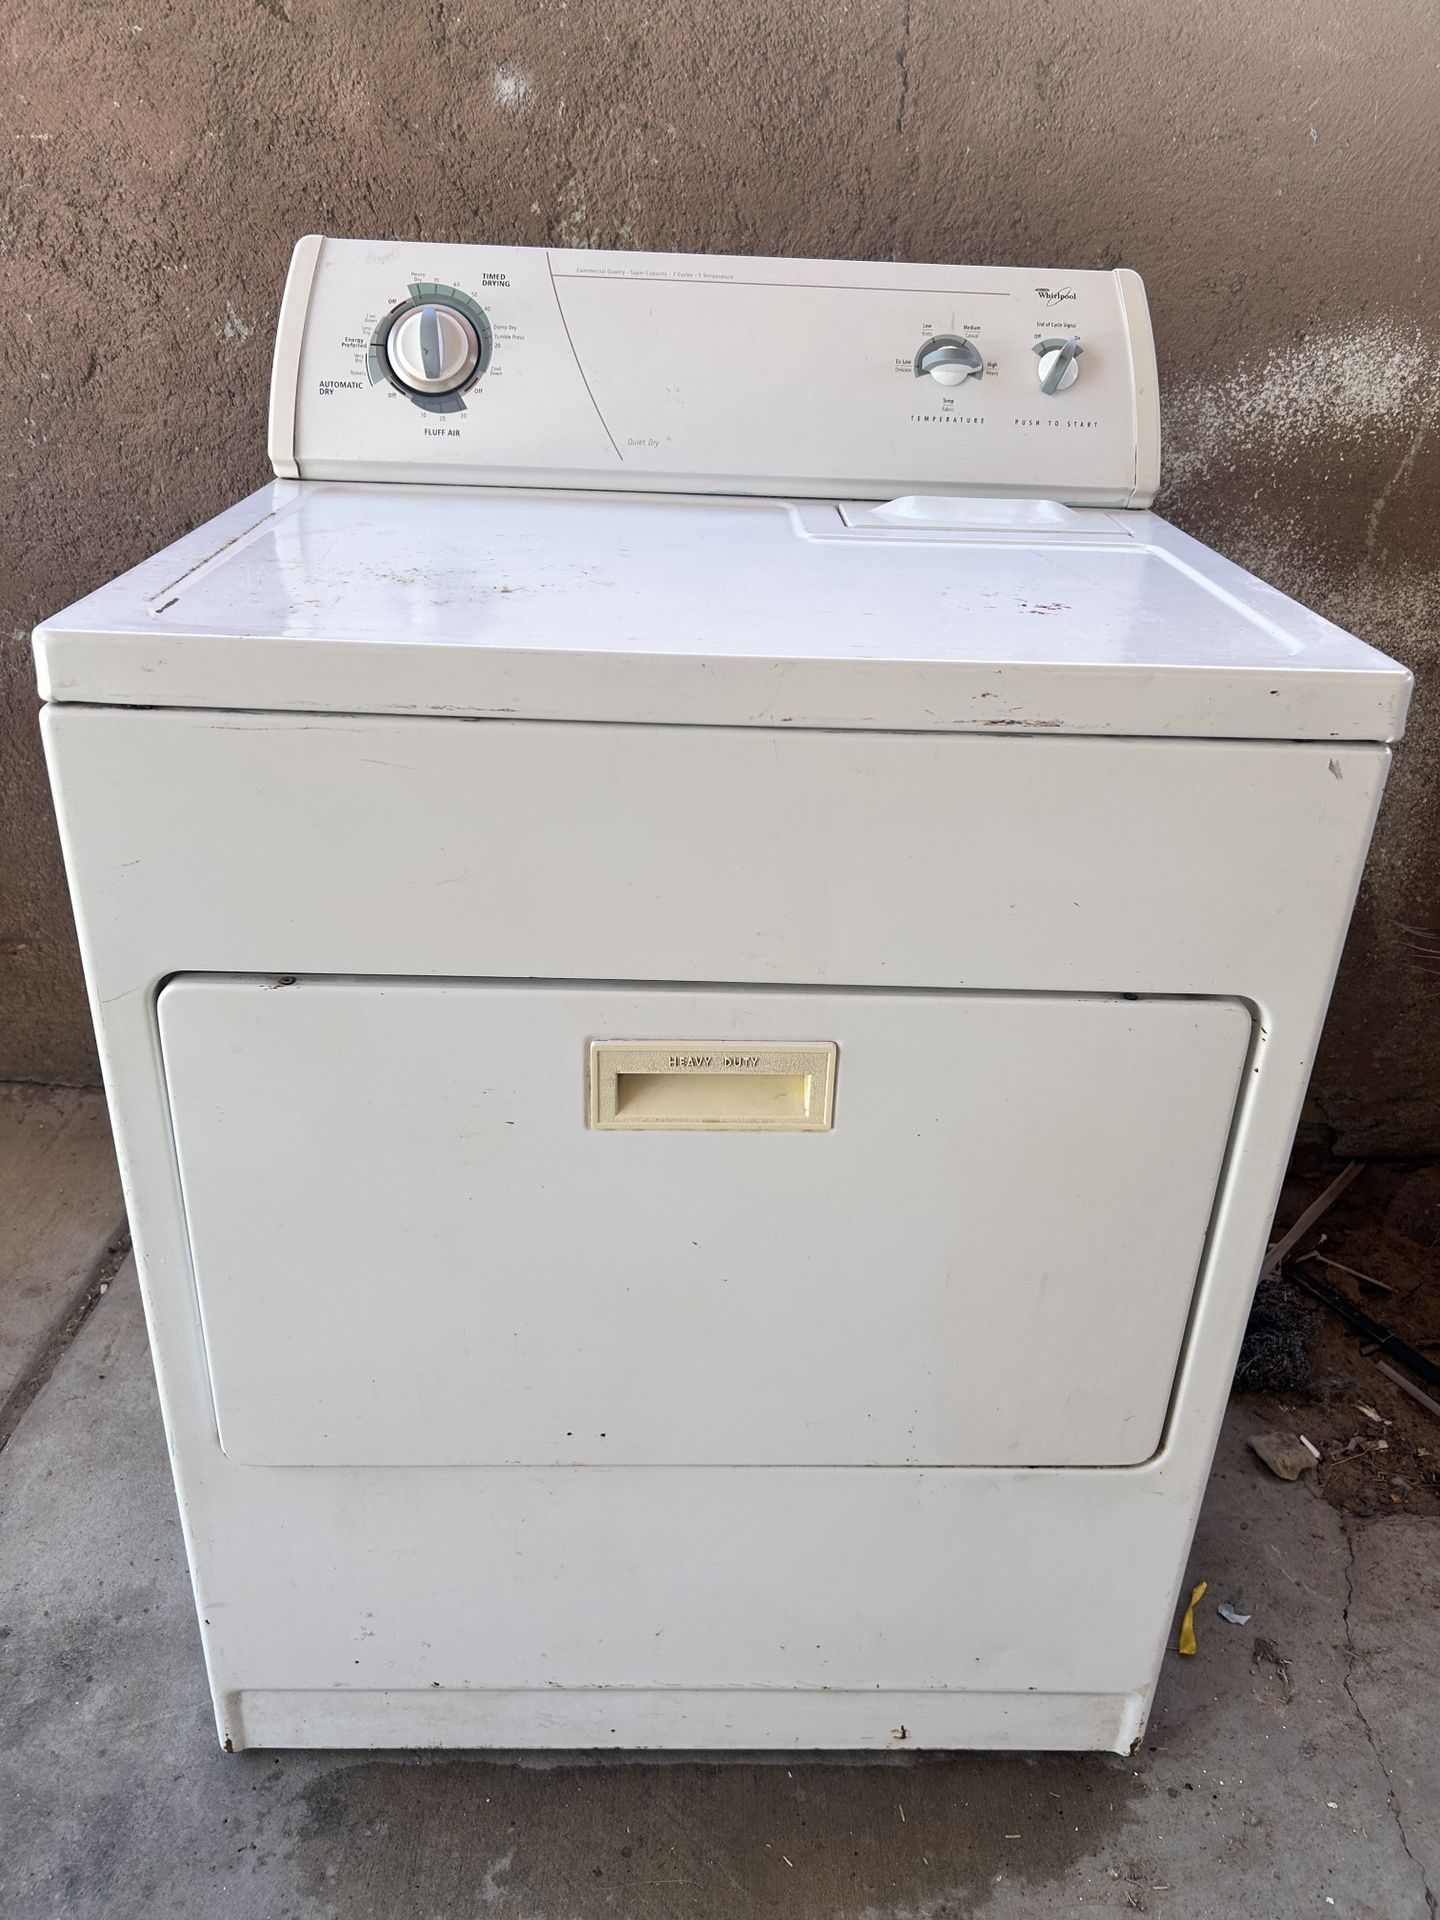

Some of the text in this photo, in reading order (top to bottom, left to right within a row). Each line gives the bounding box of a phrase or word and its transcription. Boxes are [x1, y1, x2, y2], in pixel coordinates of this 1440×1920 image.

[1038, 292, 1076, 300] Whirlpool
[320, 381, 363, 389] AUTOMATIC
[911, 416, 985, 424] TEMPERATURE
[648, 439, 660, 448] Dry
[669, 1056, 758, 1067] HEAVY DUTY
